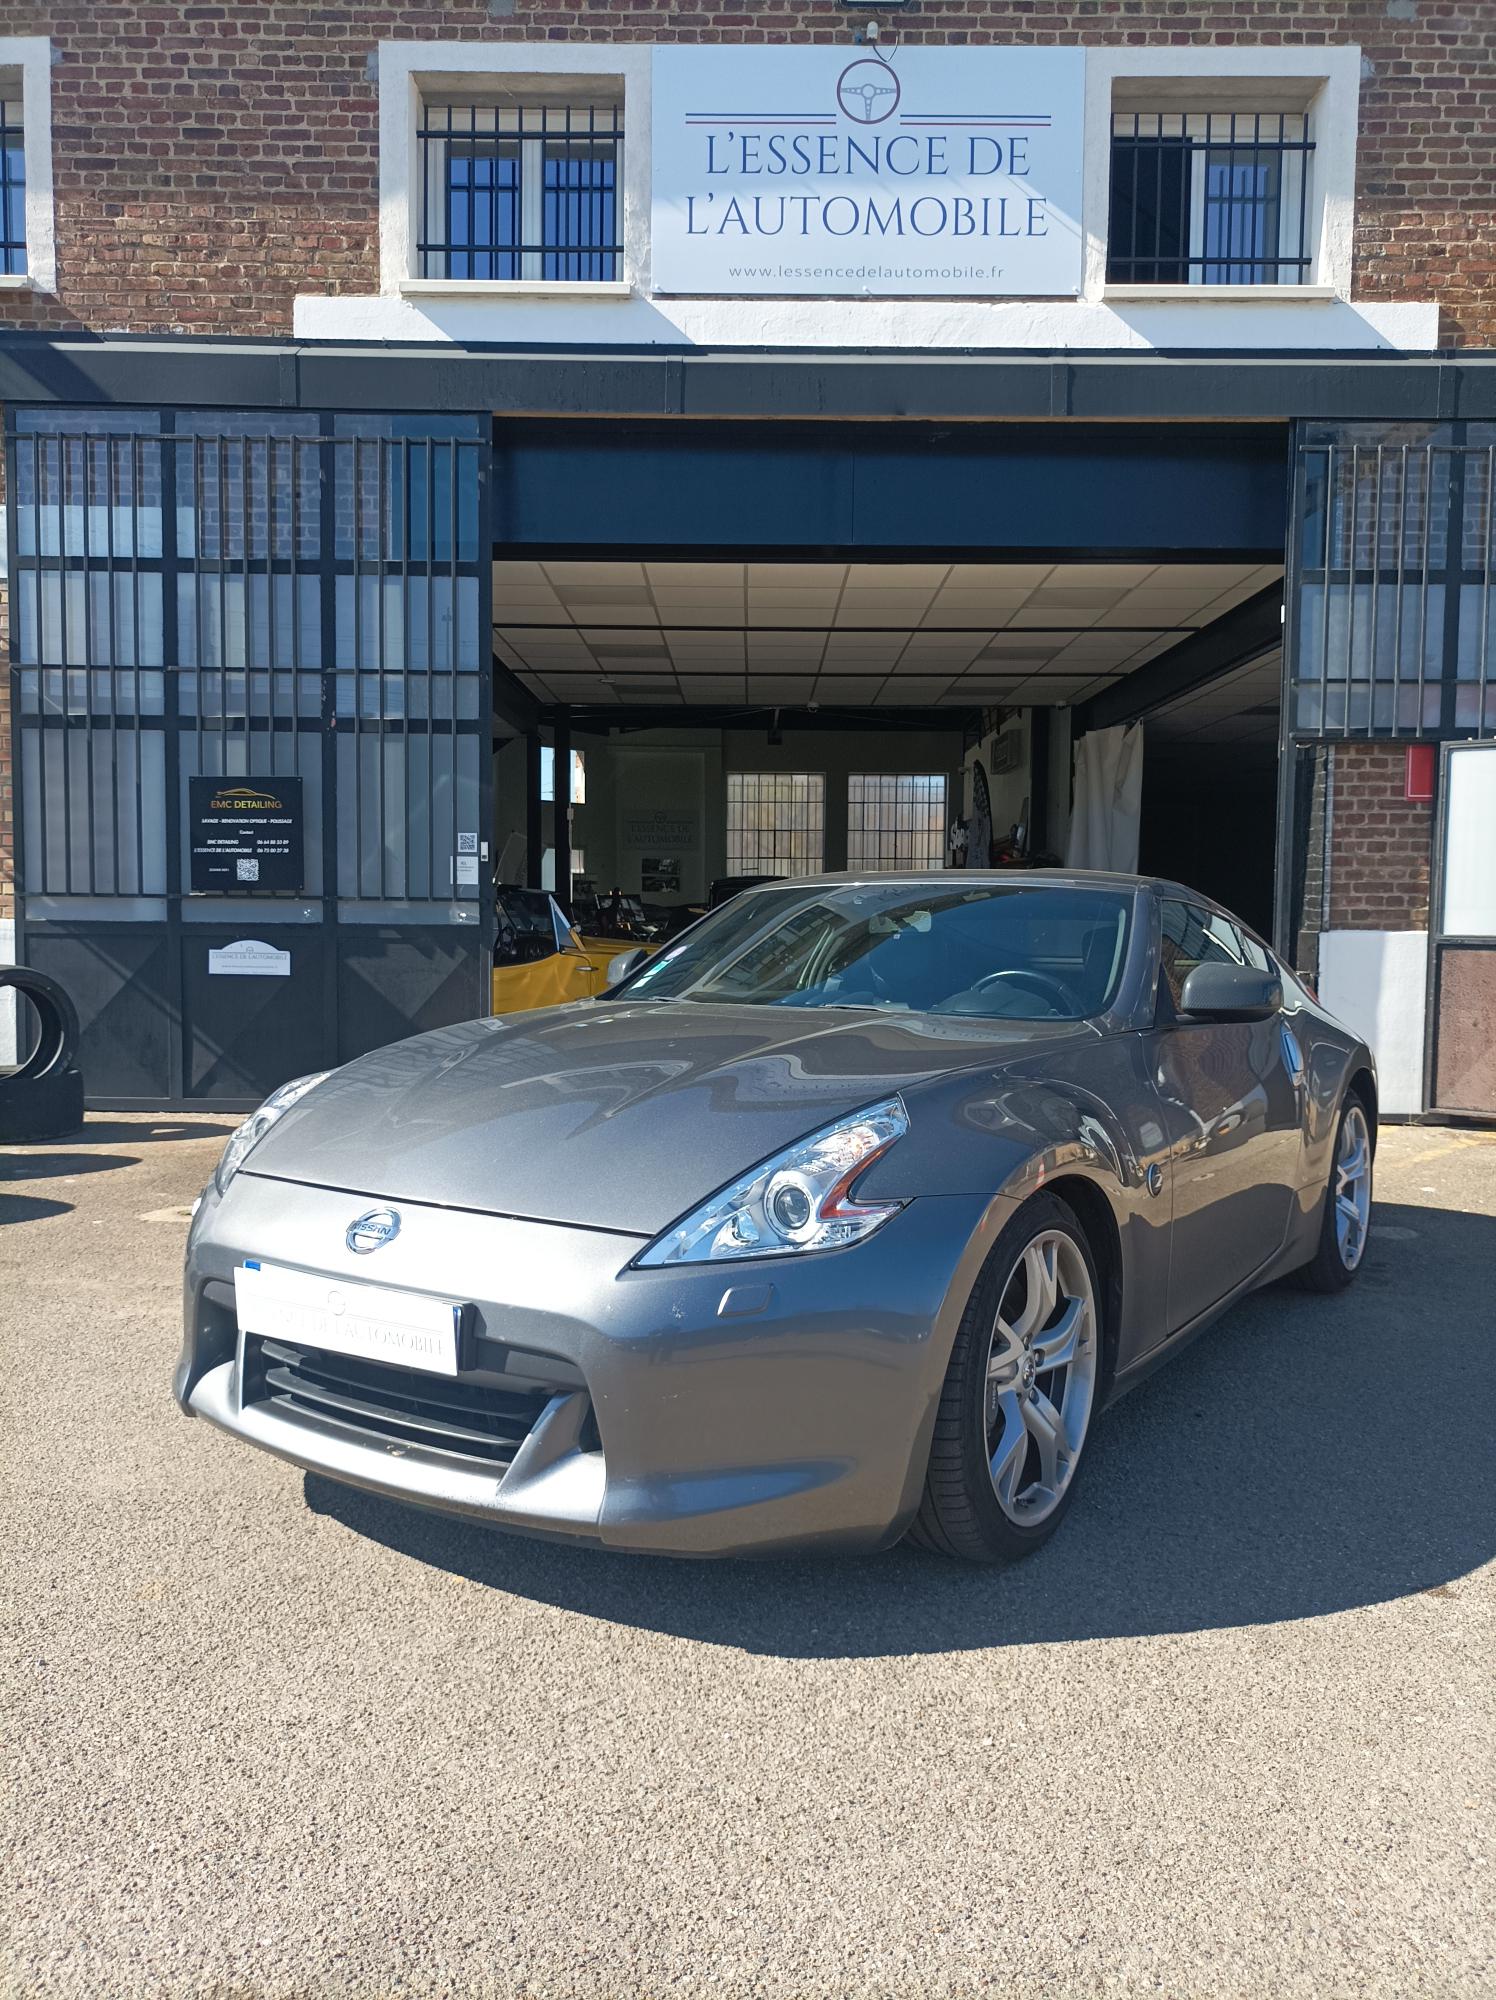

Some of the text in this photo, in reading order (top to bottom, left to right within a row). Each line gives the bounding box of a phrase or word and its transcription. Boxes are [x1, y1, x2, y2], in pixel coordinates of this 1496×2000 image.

[705, 132, 1031, 176] L'ESSENCE DE
[685, 192, 1049, 237] L'AUTOMOBILE
[728, 263, 1005, 280] www.lessencedelautomobile.fr
[210, 800, 282, 809] EMC DETAILING
[349, 1221, 392, 1236] NISSAN
